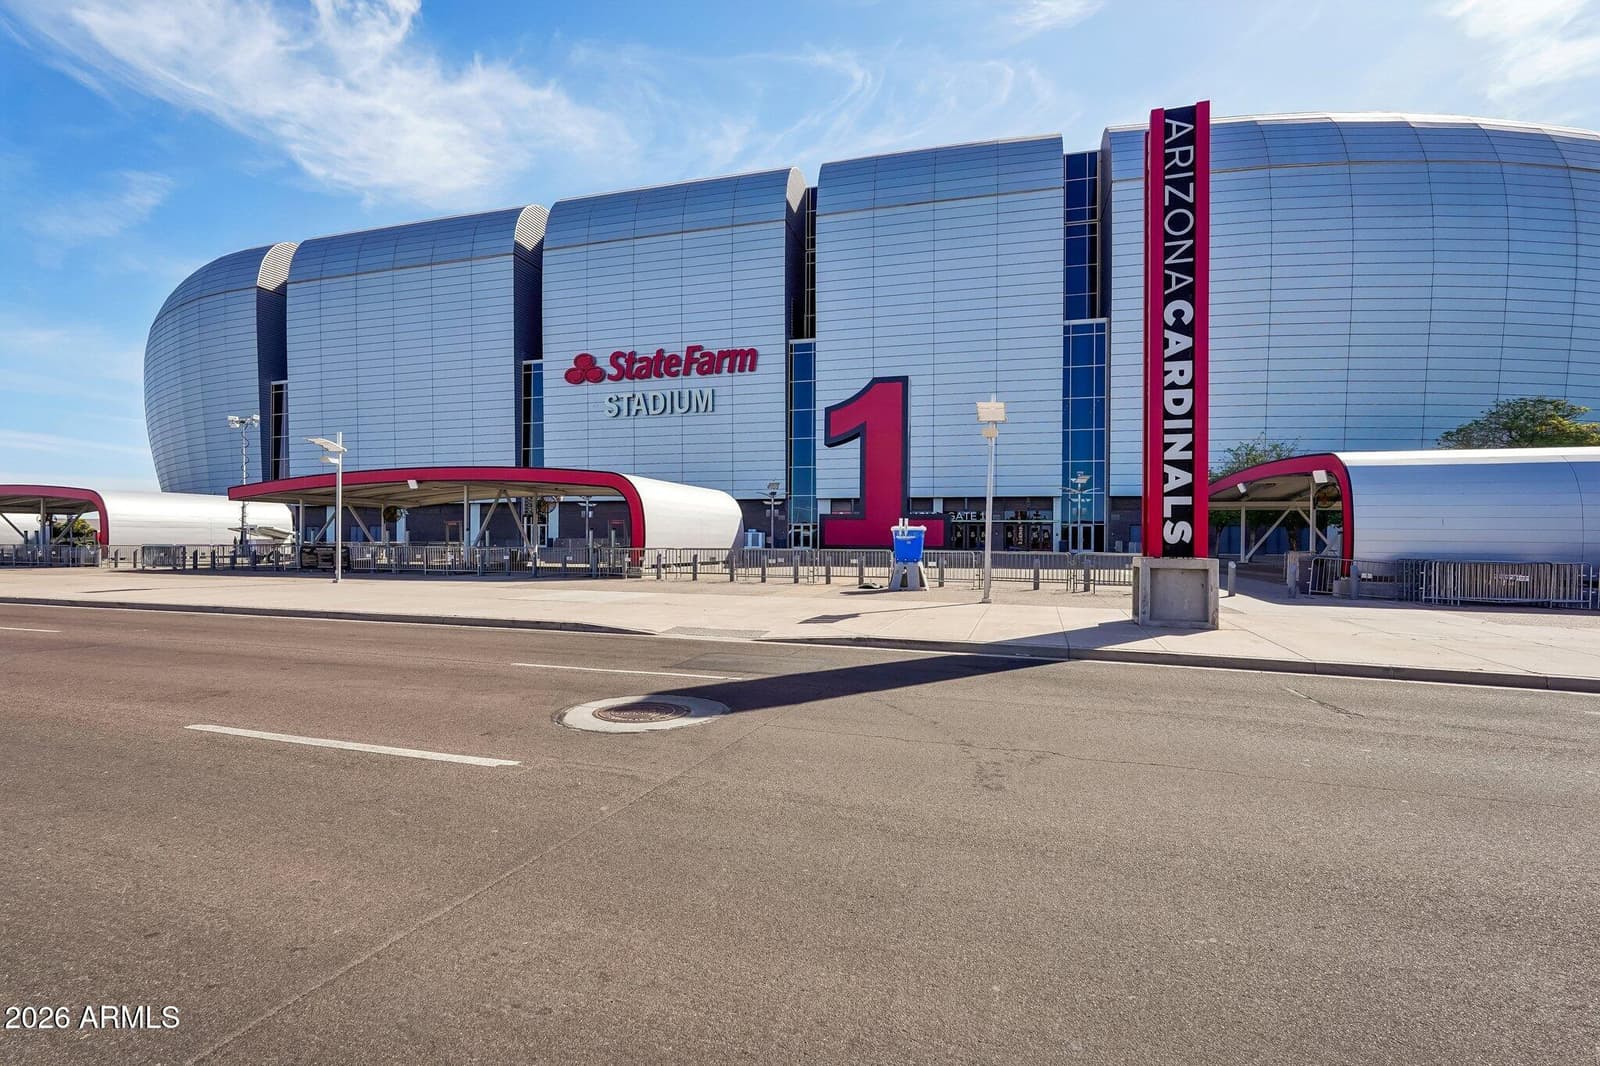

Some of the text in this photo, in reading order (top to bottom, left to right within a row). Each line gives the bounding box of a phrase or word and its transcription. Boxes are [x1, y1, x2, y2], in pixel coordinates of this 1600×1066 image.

[1162, 117, 1195, 546] ARIZONA CARDINALS
[604, 388, 715, 418] STADIUM
[819, 375, 951, 549] 1
[949, 511, 977, 521] GATE
